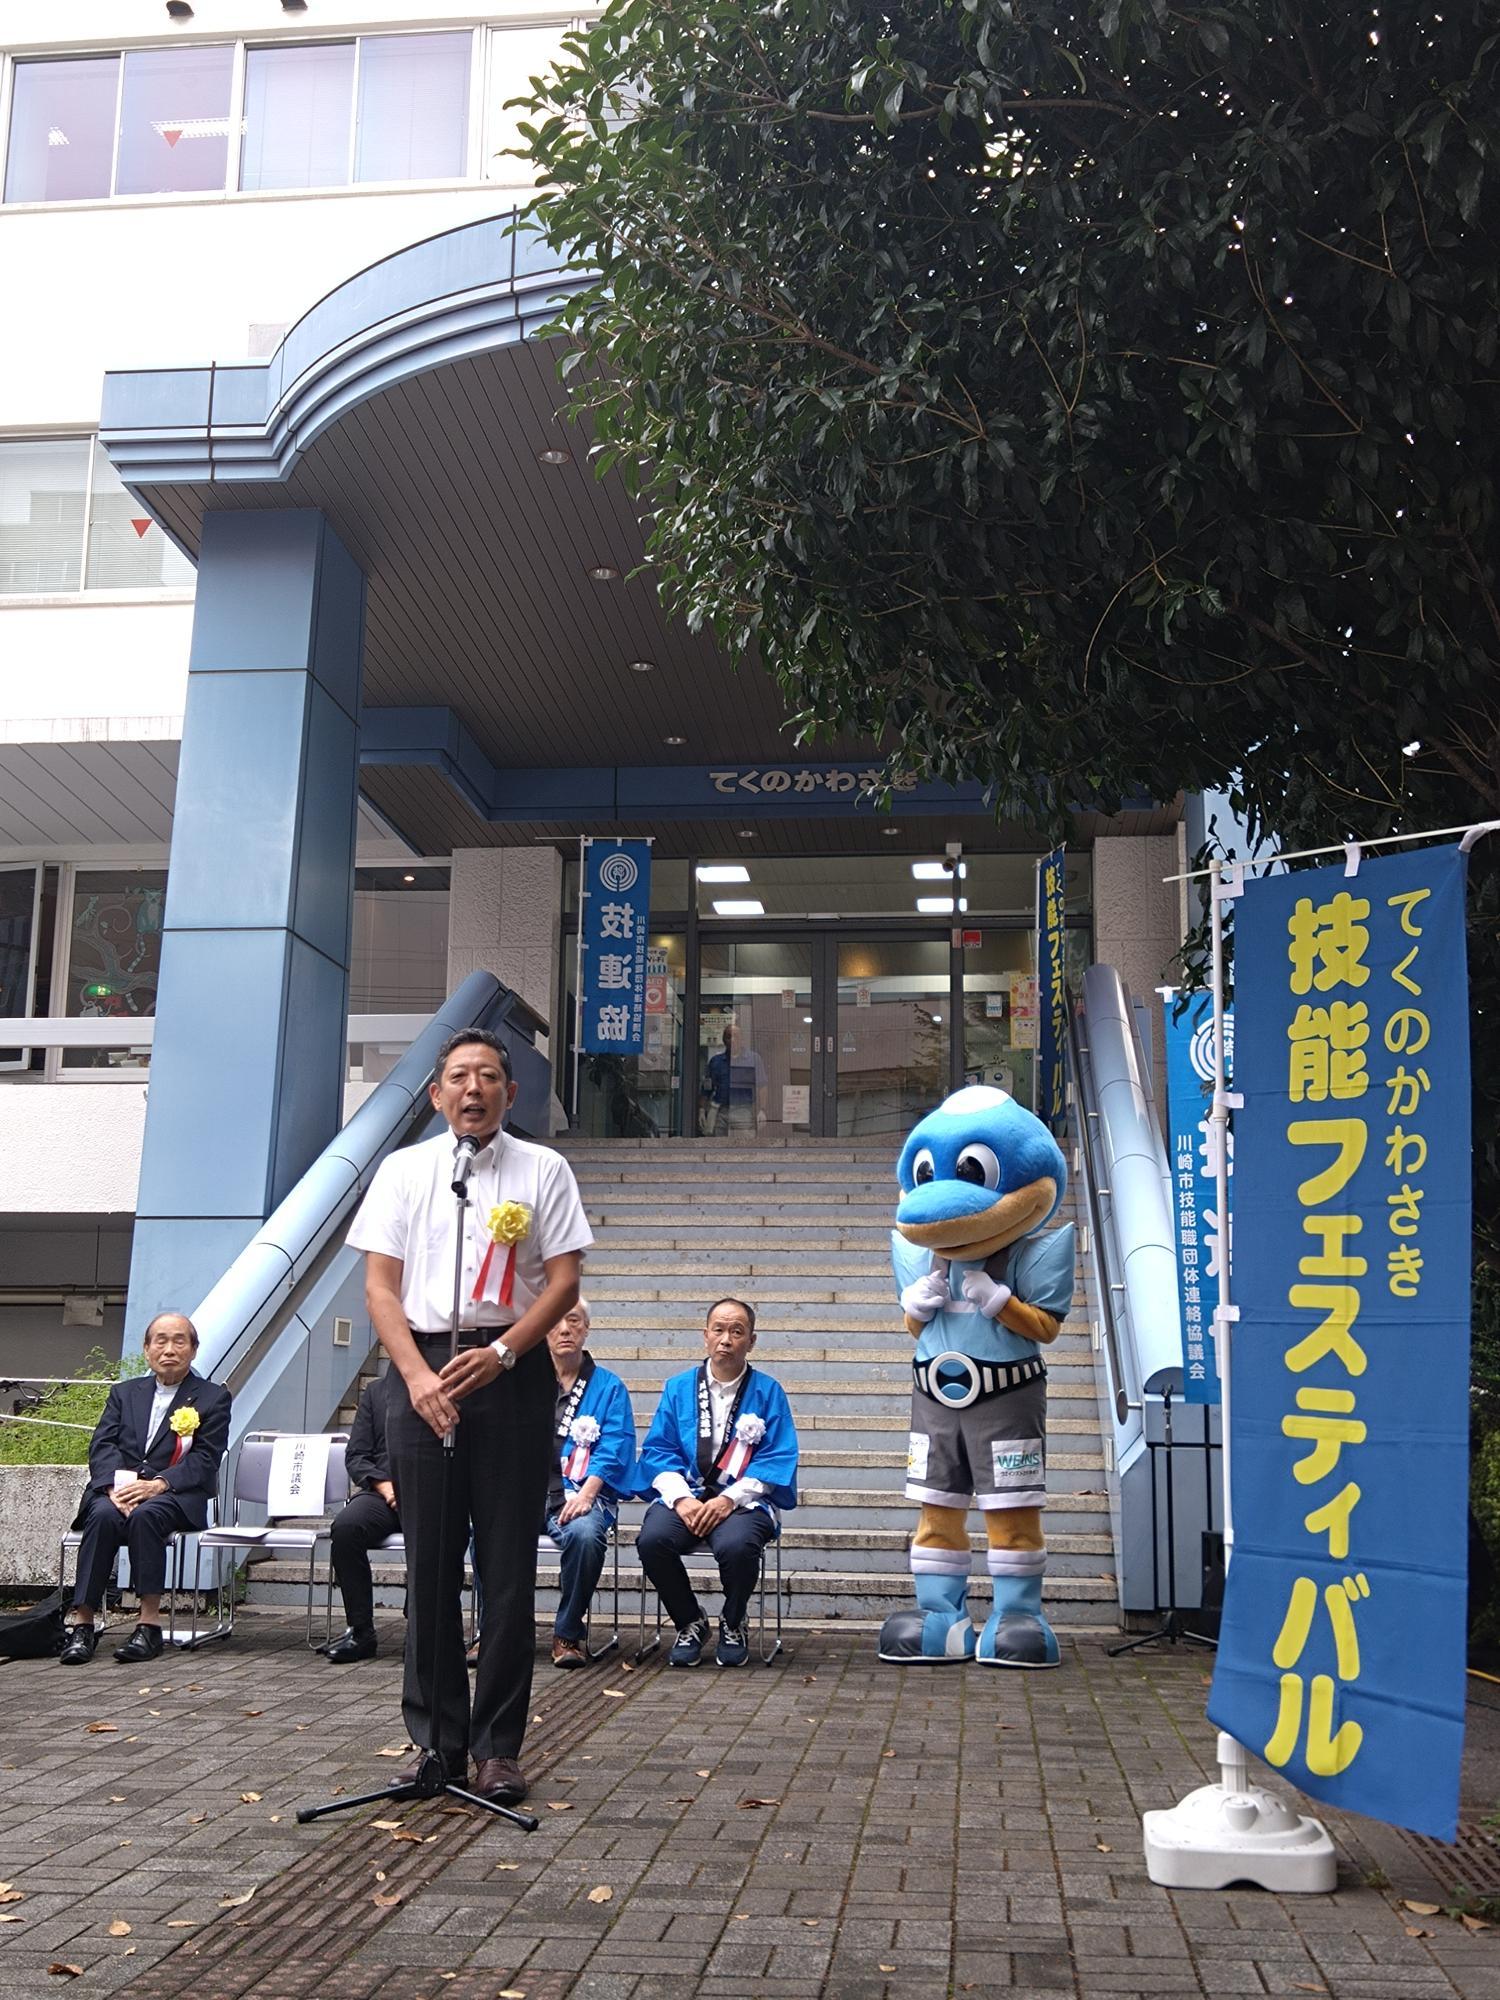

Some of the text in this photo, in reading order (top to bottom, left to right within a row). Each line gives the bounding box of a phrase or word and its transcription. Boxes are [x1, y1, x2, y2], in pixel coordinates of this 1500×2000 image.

[1383, 887, 1432, 1298] てくのかわさき
[1177, 1134, 1206, 1380] 川崎市技能職団体連絡協議会
[1265, 891, 1371, 1777] 技能フェスティバル
[290, 1443, 306, 1495] 川崎市議会
